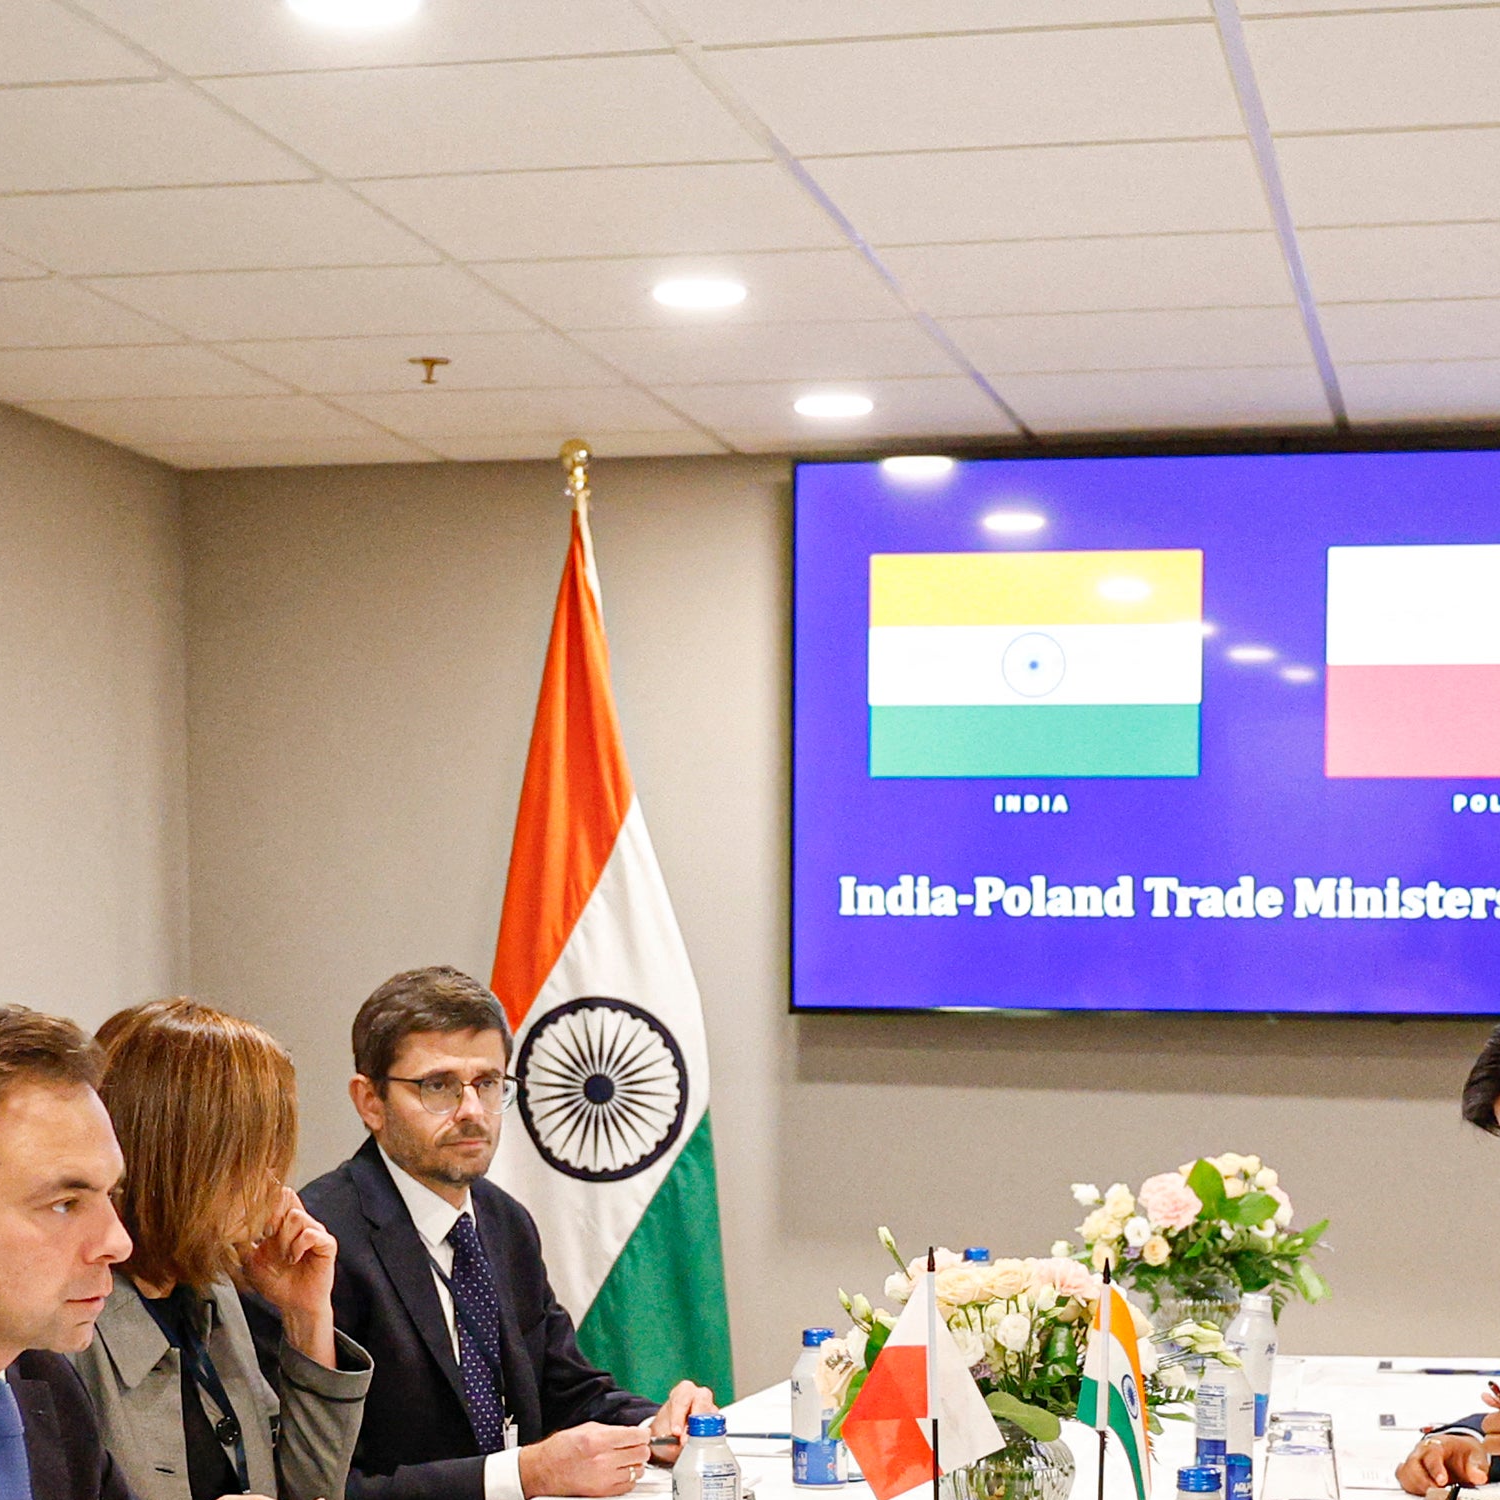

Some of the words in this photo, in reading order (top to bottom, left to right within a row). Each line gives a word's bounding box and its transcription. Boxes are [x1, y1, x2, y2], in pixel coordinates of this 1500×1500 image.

[994, 794, 1069, 813] INDIA
[838, 875, 1135, 918] India-Poland
[1143, 875, 1285, 919] Trade
